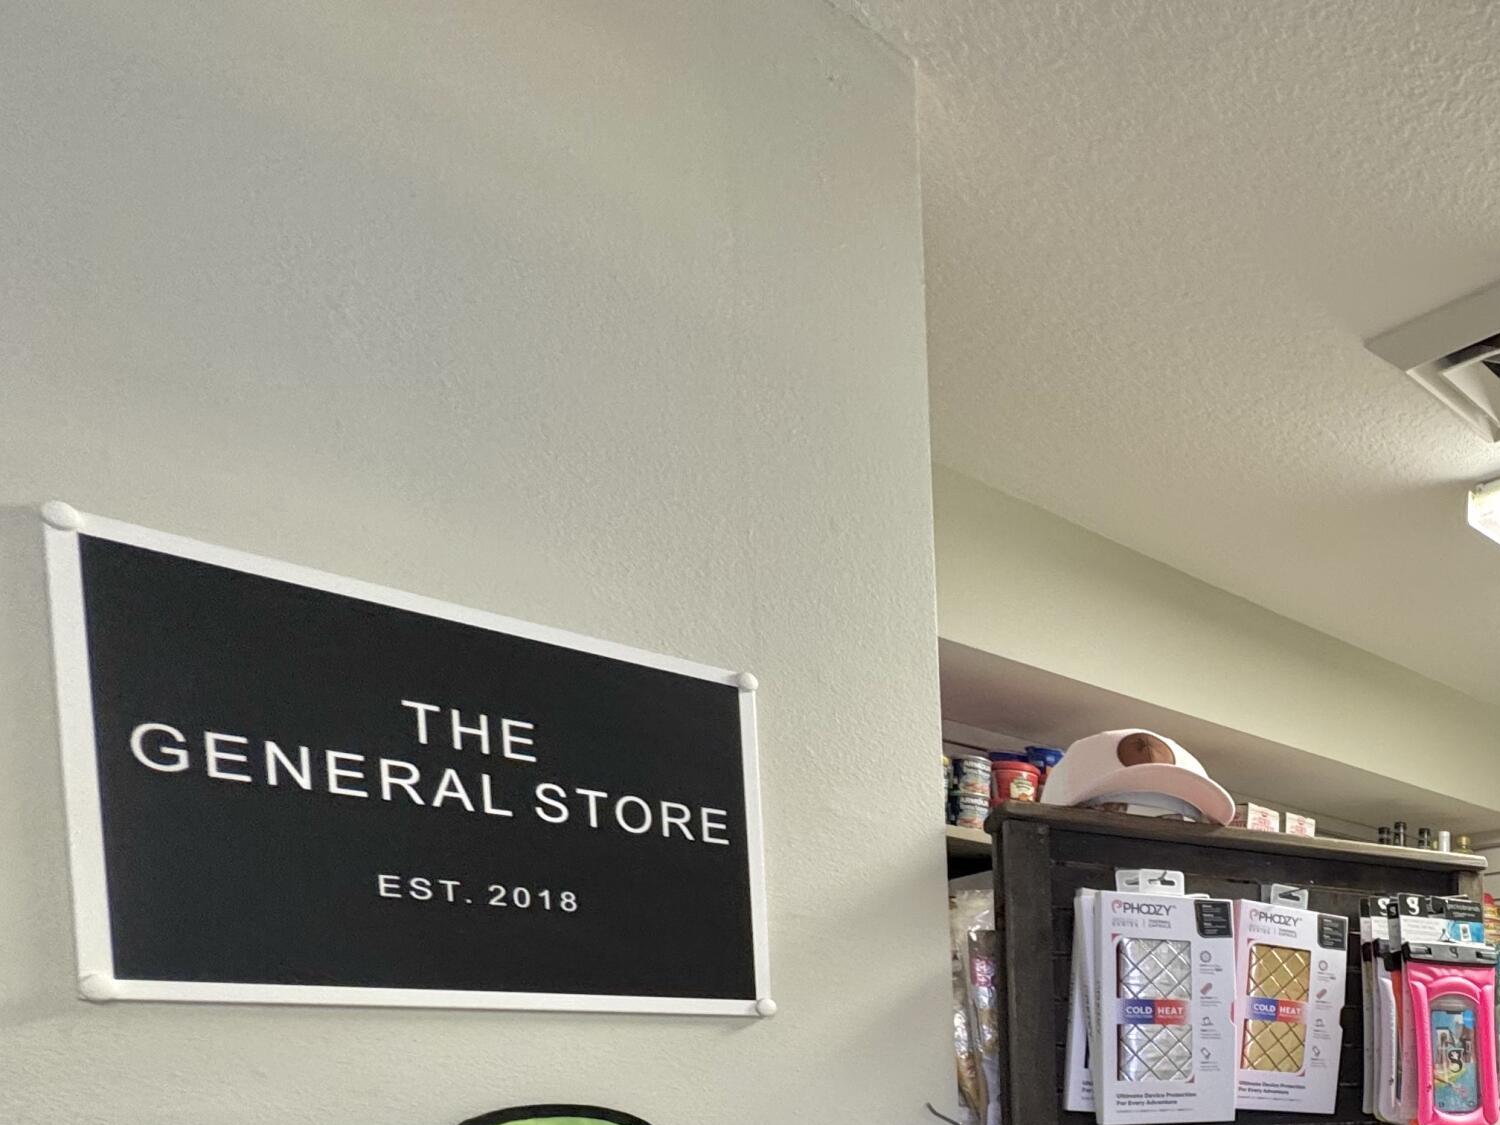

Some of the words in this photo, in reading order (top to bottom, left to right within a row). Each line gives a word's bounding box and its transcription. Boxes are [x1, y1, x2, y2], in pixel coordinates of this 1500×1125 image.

[401, 699, 538, 763] THE
[129, 722, 513, 818] GENERAL
[534, 783, 731, 846] STORE
[377, 873, 474, 905] EST.
[488, 884, 580, 914] 2018
[1125, 1006, 1153, 1016] COLD
[1156, 1006, 1185, 1016] HEAT
[1254, 1003, 1277, 1014] COLD
[1279, 1005, 1302, 1016] HEAT
